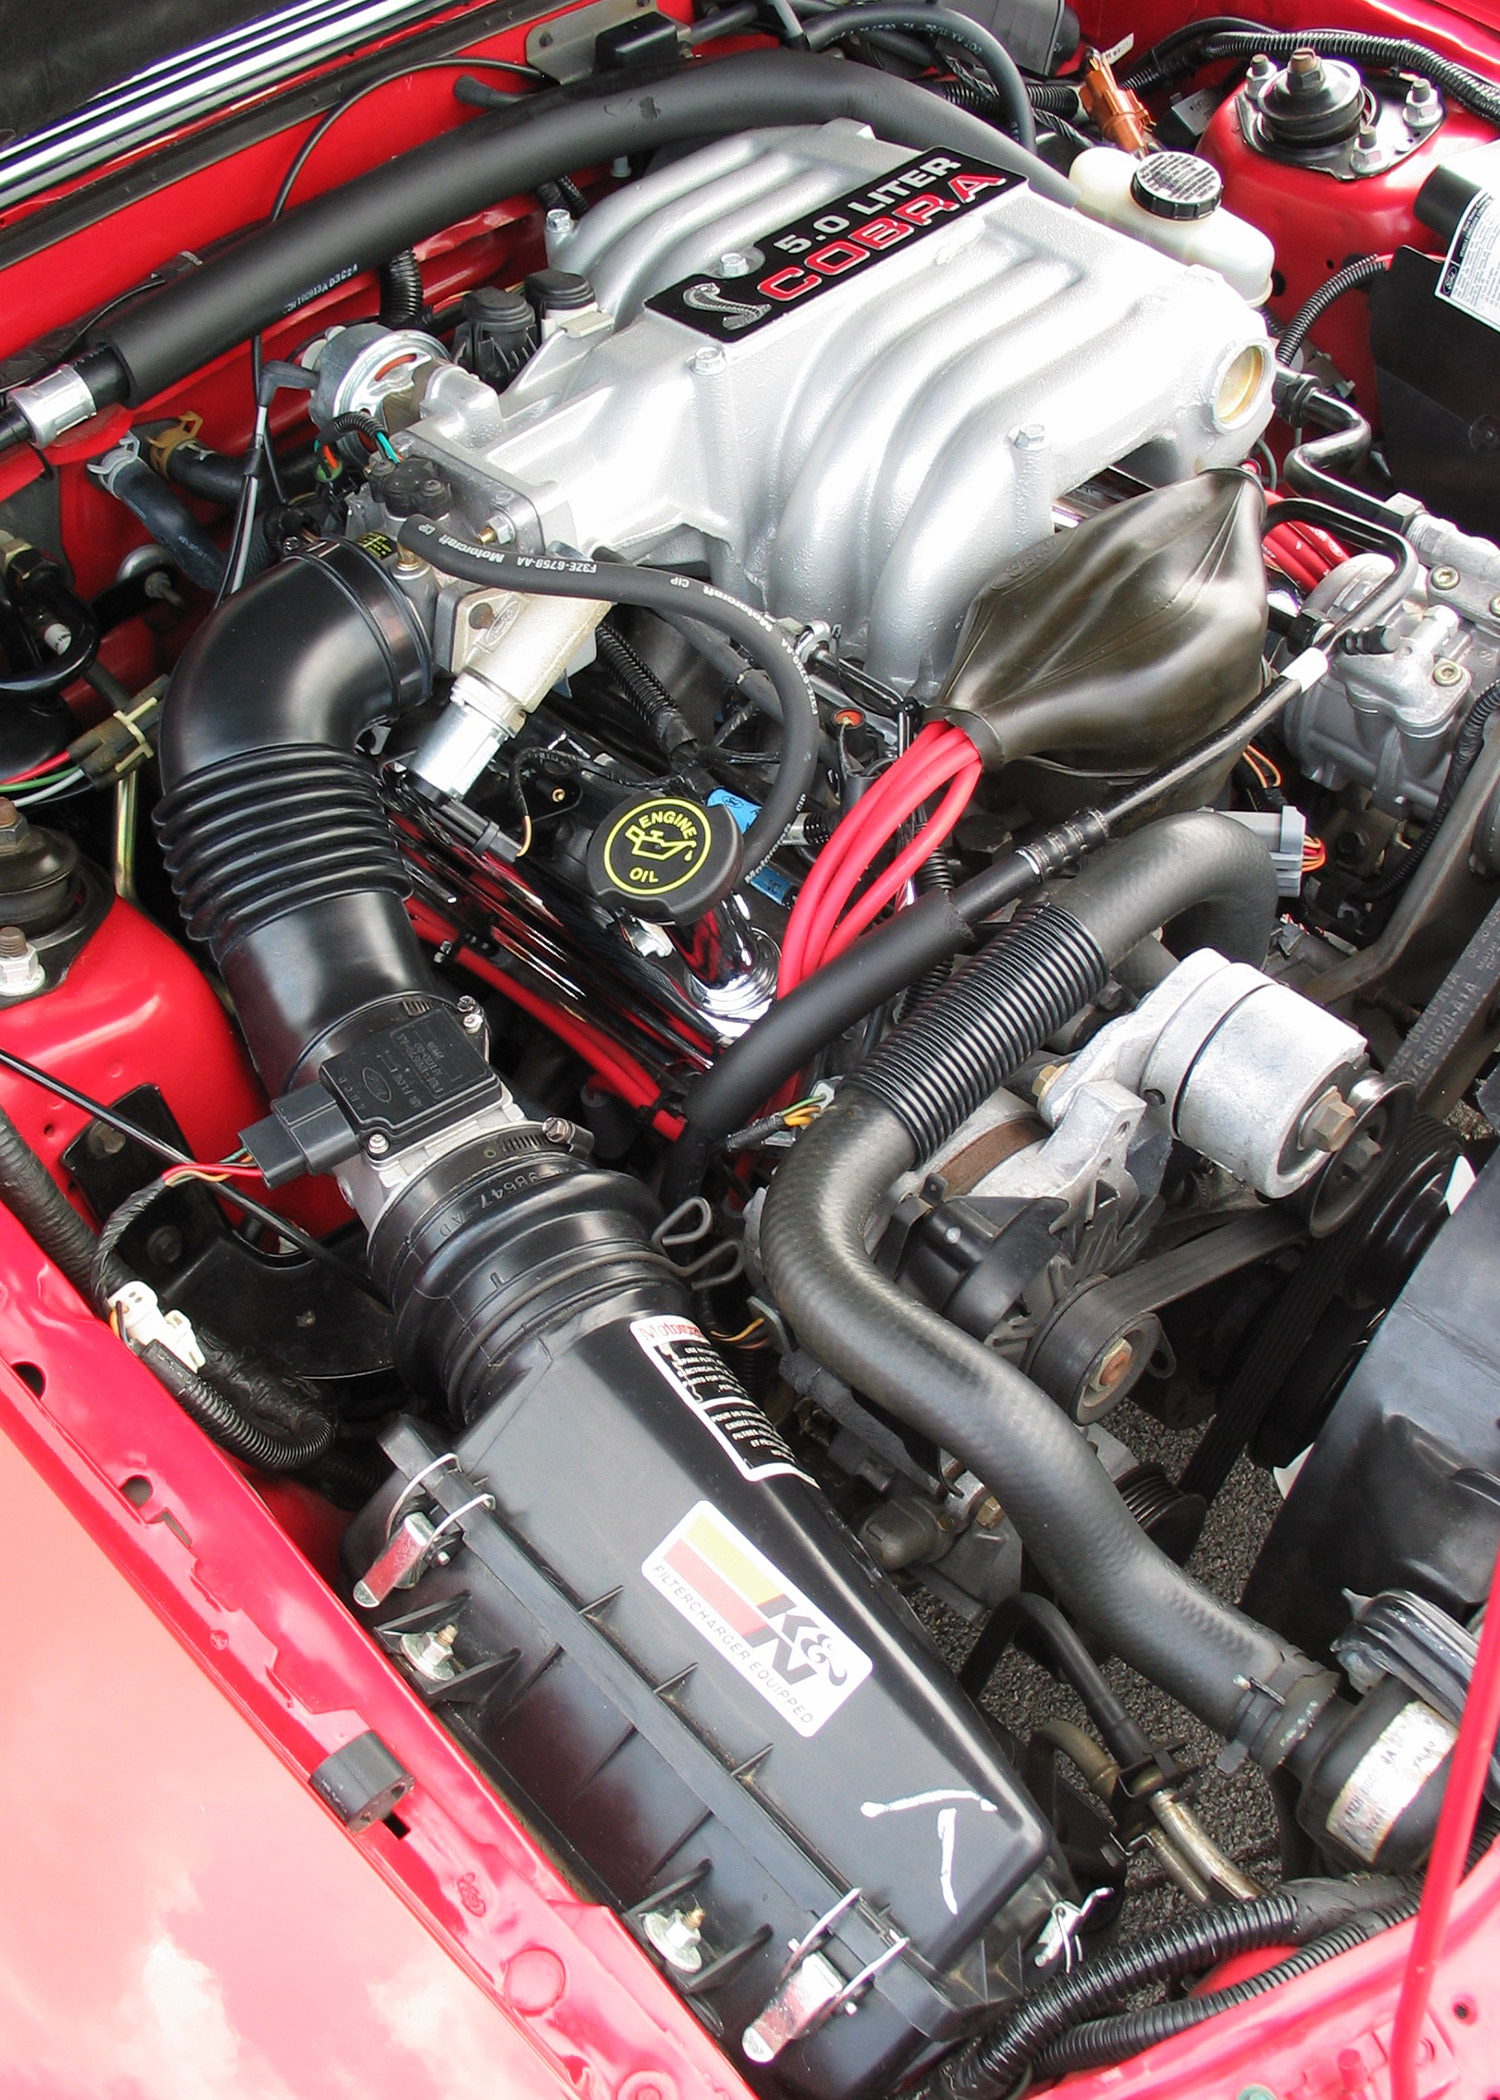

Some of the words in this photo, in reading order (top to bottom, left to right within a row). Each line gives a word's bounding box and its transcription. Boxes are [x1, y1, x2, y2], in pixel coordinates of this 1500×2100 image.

[773, 215, 850, 254] 5.0
[848, 156, 961, 216] LITER
[757, 173, 1006, 301] COBRA
[437, 535, 505, 563] Motorcraft
[670, 576, 690, 589] CIP
[703, 584, 774, 633] Motorcraft
[638, 810, 698, 840] ENGINE
[629, 866, 659, 883] OIL
[652, 1564, 751, 1661] FILTERCHARGER
[749, 1662, 814, 1724] EQUIPPED
